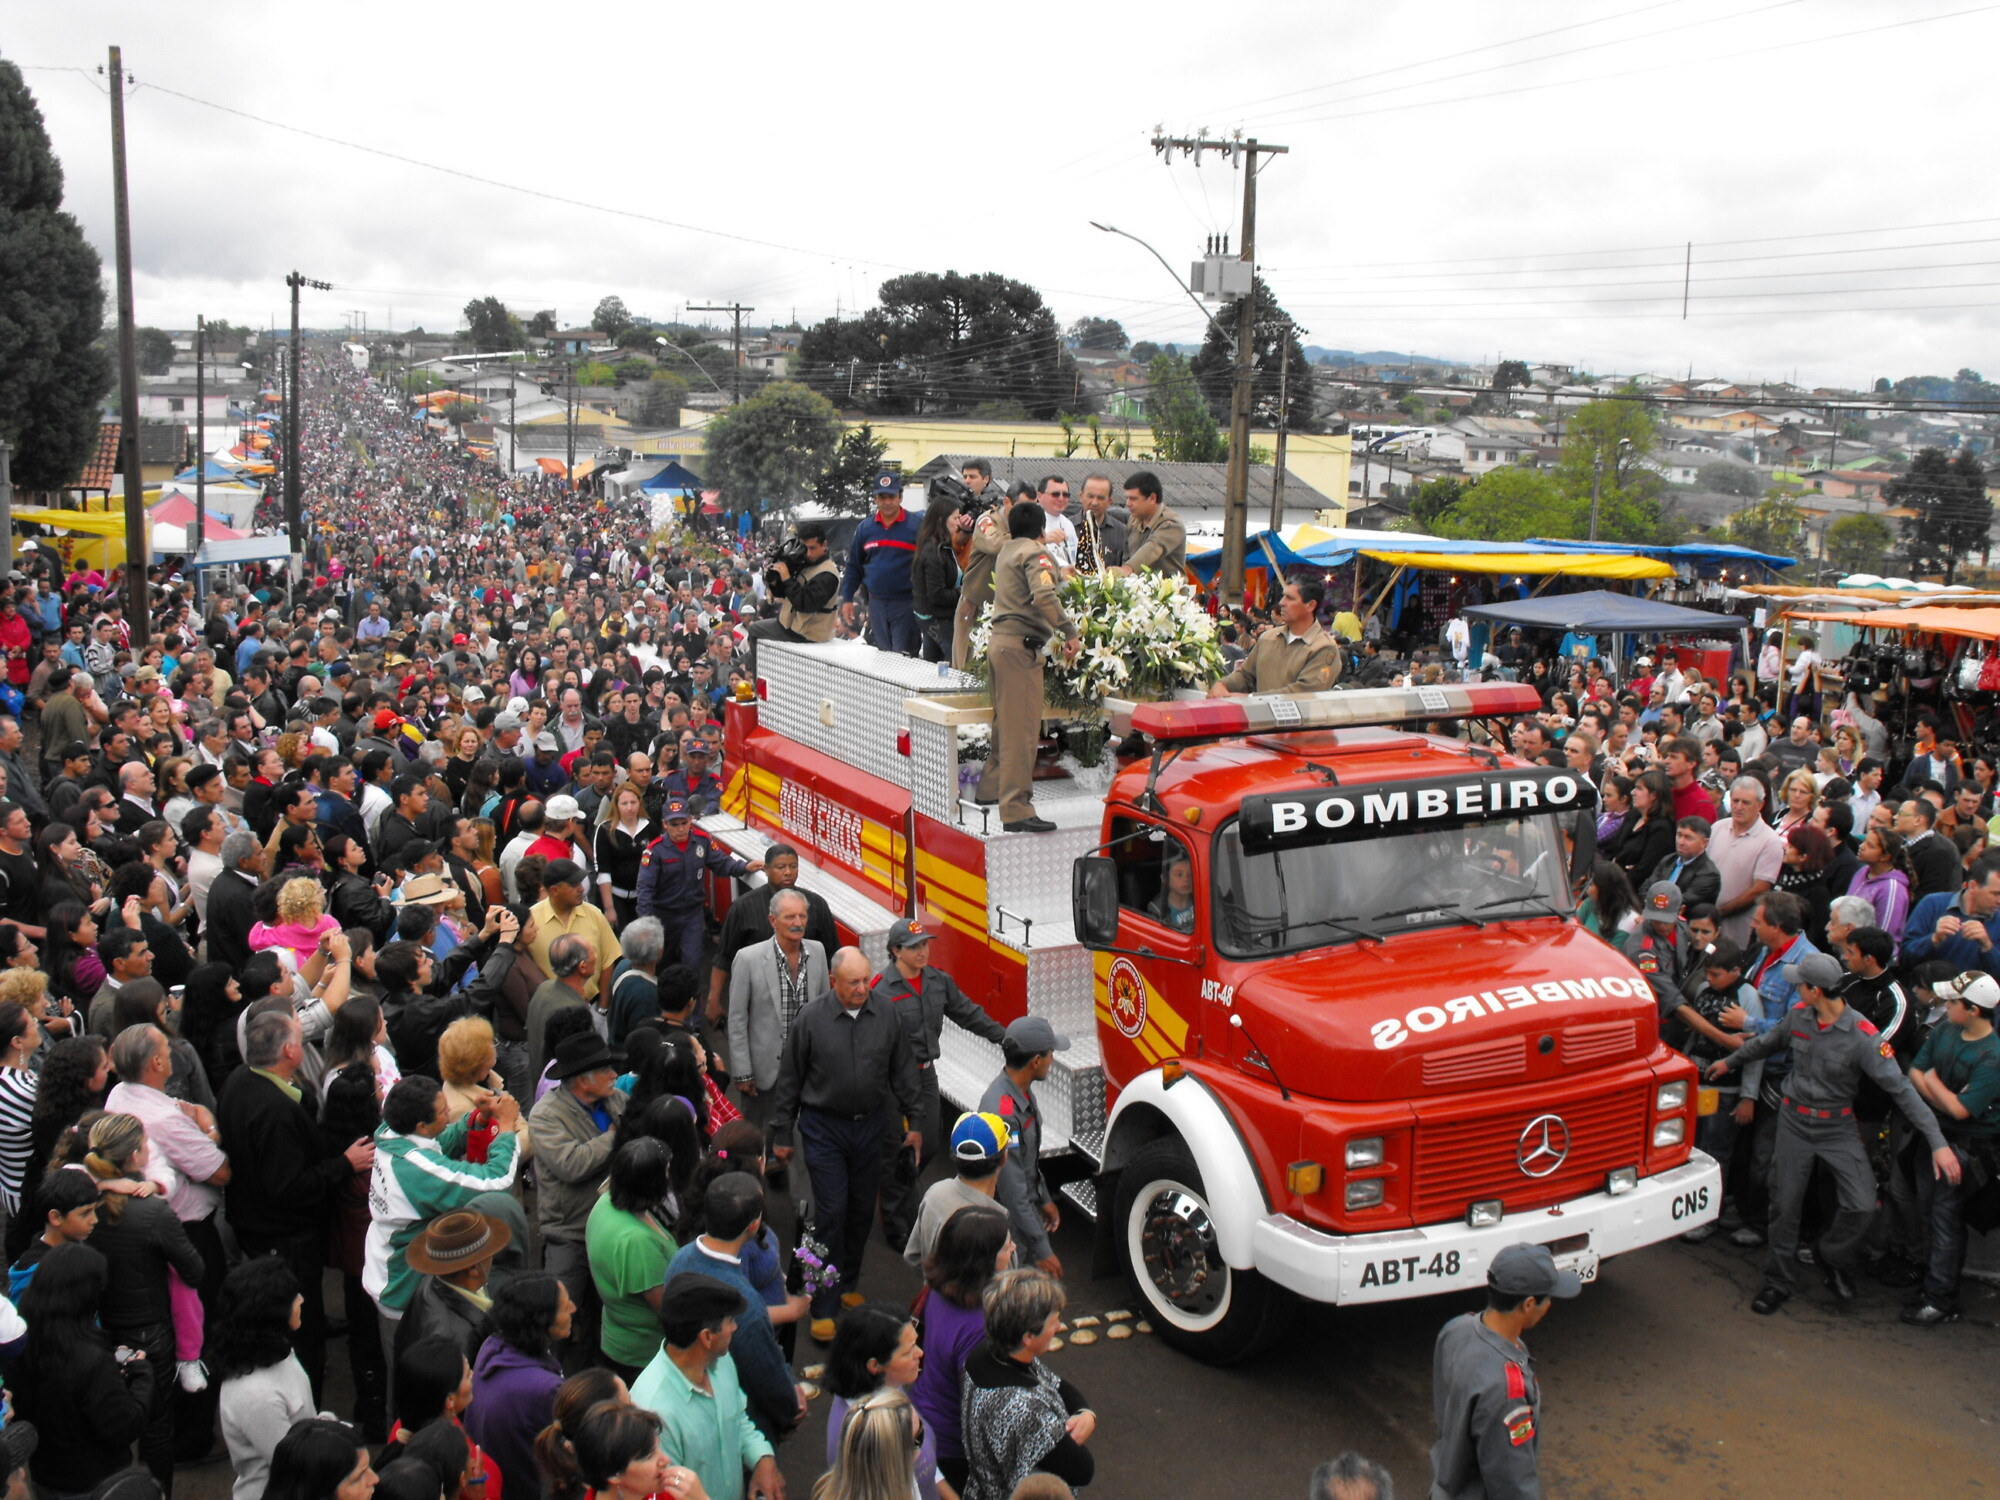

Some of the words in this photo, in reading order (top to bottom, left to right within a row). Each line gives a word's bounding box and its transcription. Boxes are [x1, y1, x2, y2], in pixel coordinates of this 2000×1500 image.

[1272, 775, 1578, 833] BOMBEIRO
[1201, 978, 1234, 1007] ABT-48
[1672, 1186, 1708, 1220] CNS
[1359, 1250, 1460, 1288] ABT-48
